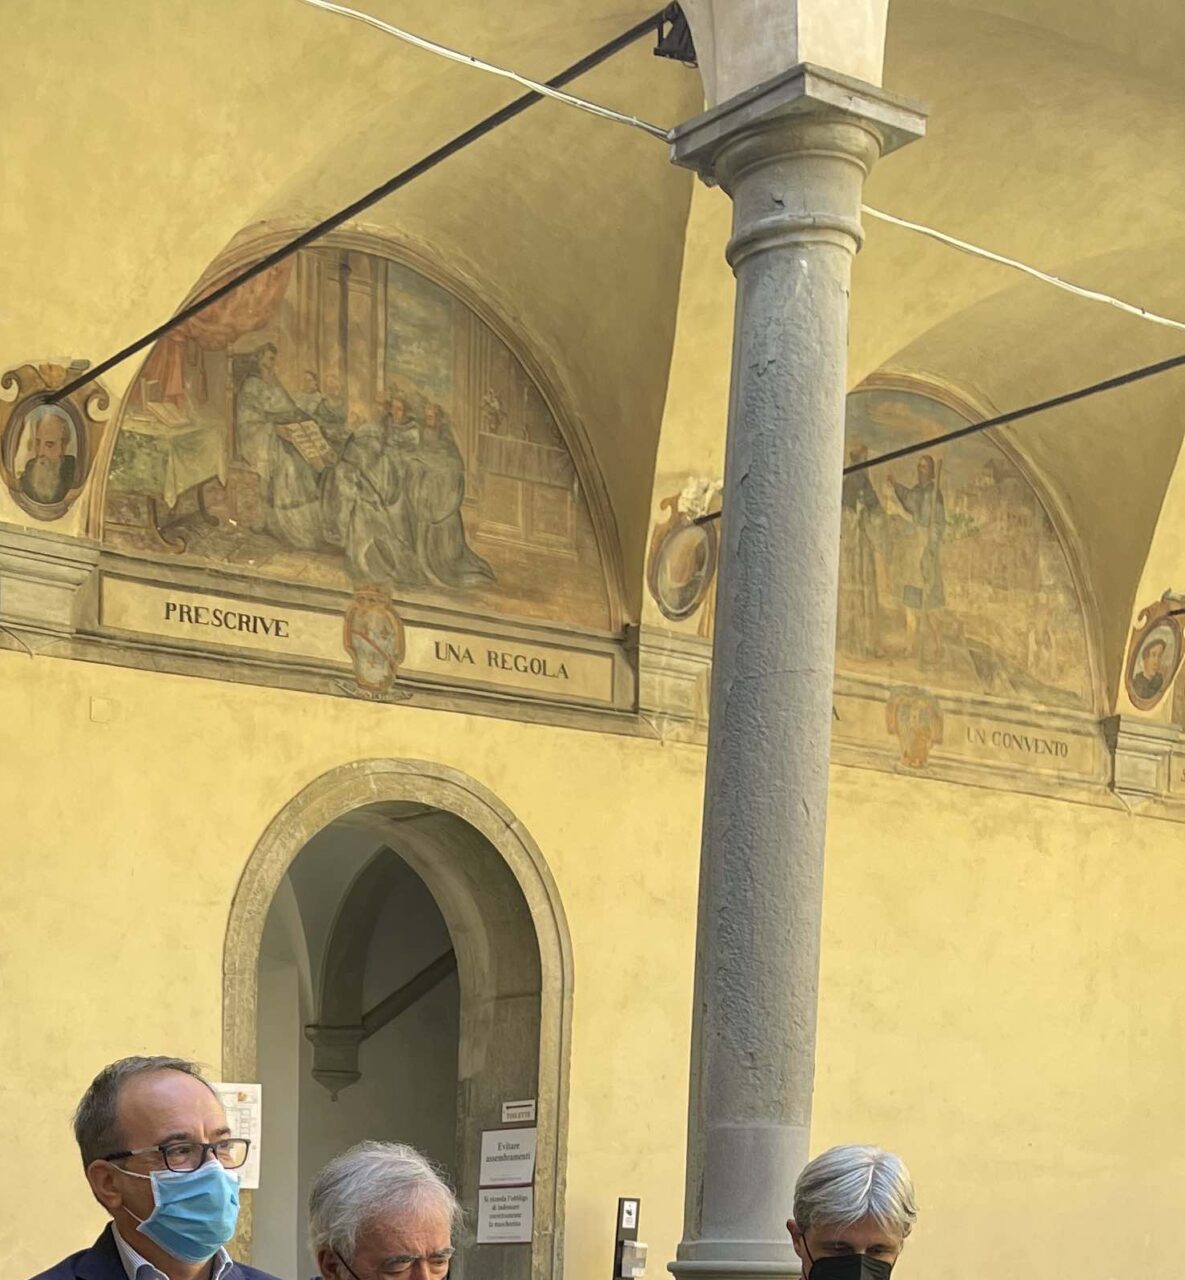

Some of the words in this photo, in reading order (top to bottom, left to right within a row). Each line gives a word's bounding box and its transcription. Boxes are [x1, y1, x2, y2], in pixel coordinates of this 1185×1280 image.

[164, 602, 290, 638] PRESCRIVE
[434, 641, 475, 665] UNA
[487, 650, 570, 680] REGOLA
[966, 727, 986, 745] UN
[991, 731, 1069, 758] CONVENTO
[497, 1142, 520, 1151] Evitare
